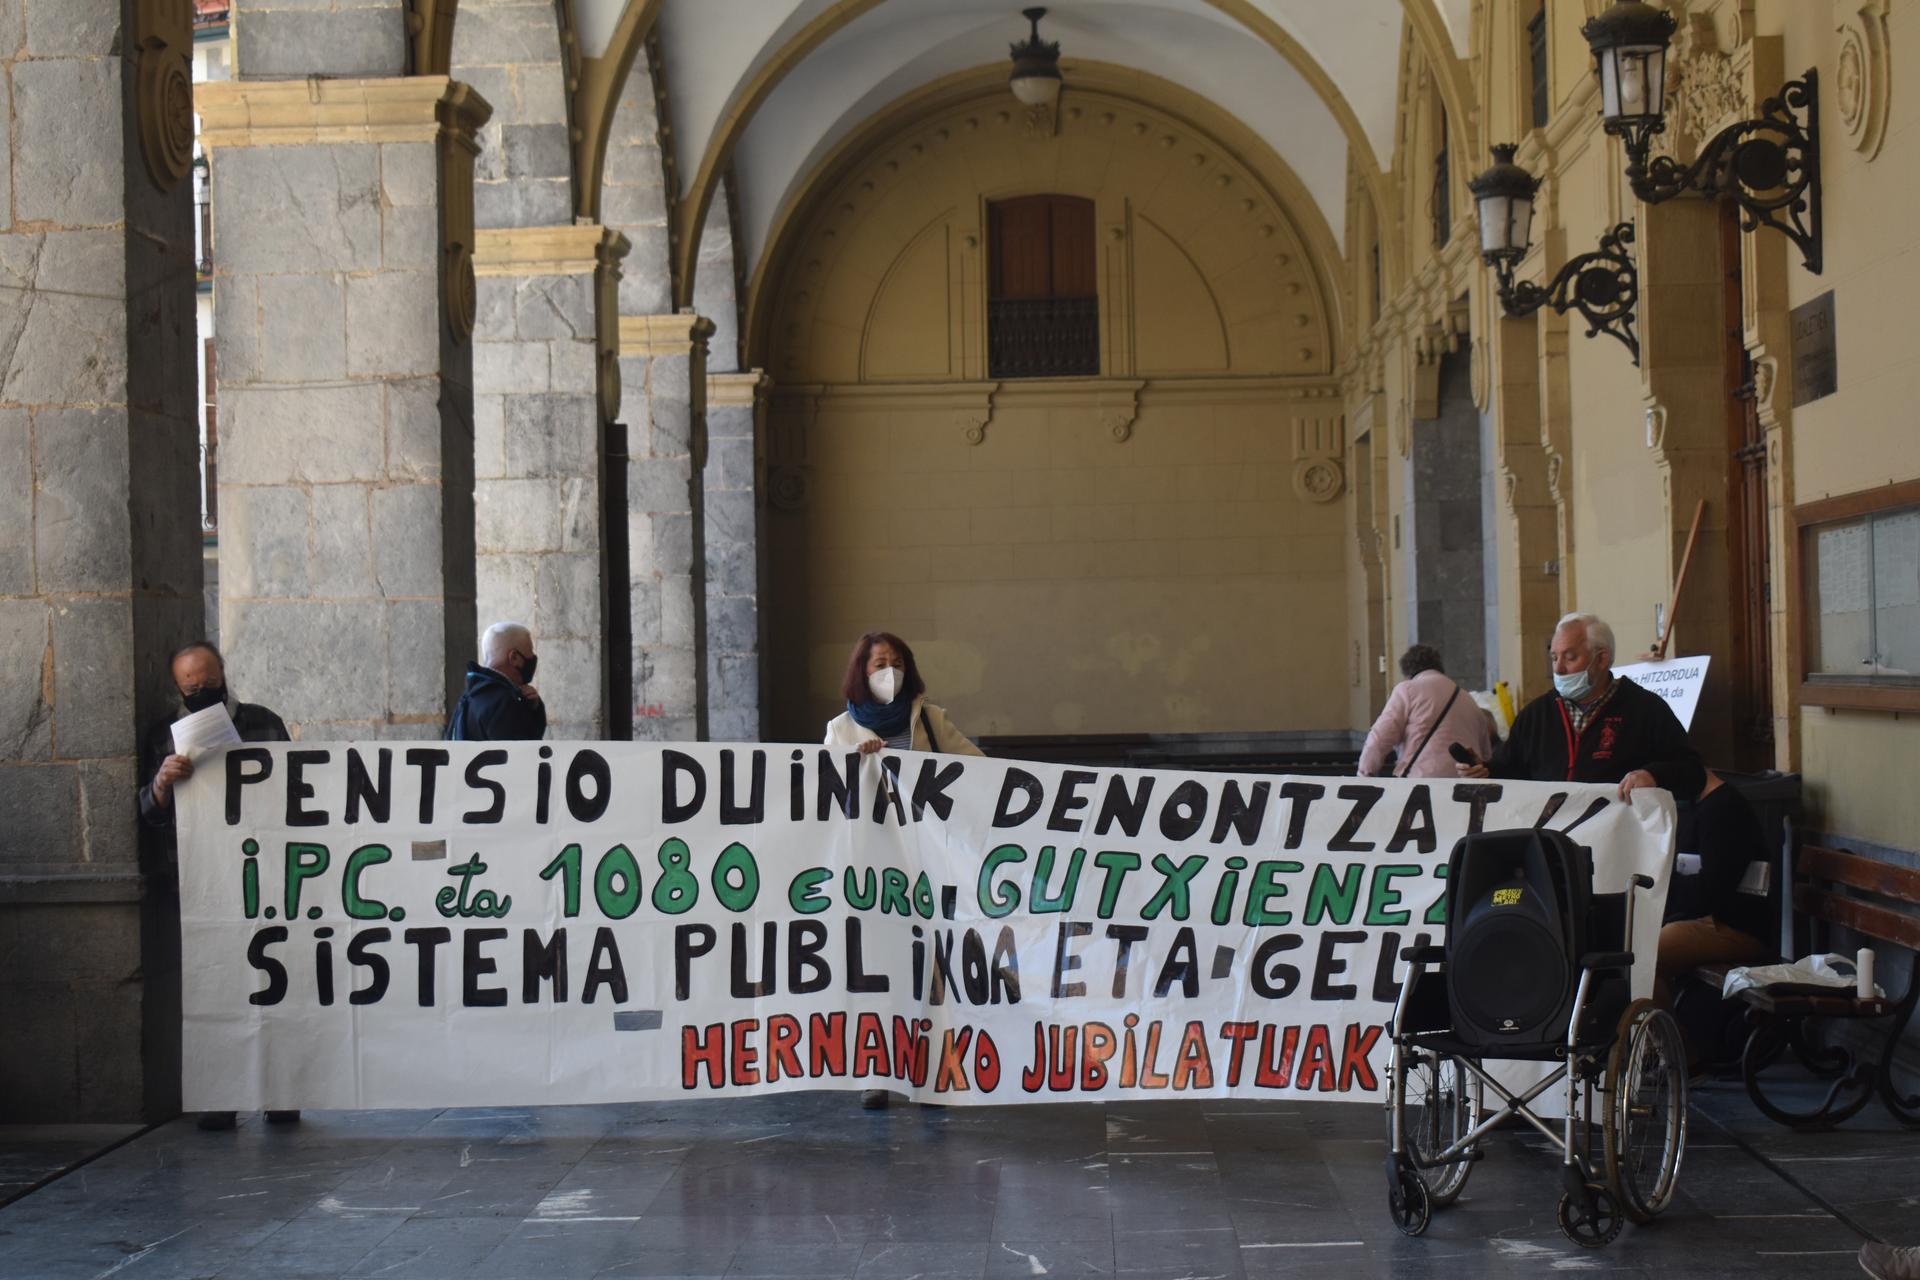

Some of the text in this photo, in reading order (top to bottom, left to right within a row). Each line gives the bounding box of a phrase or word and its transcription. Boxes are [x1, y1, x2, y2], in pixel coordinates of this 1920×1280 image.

[1640, 668, 1699, 684] HITZORDUA
[436, 852, 511, 918] eta
[539, 837, 759, 920] 1080
[1051, 921, 1199, 1000] ETA
